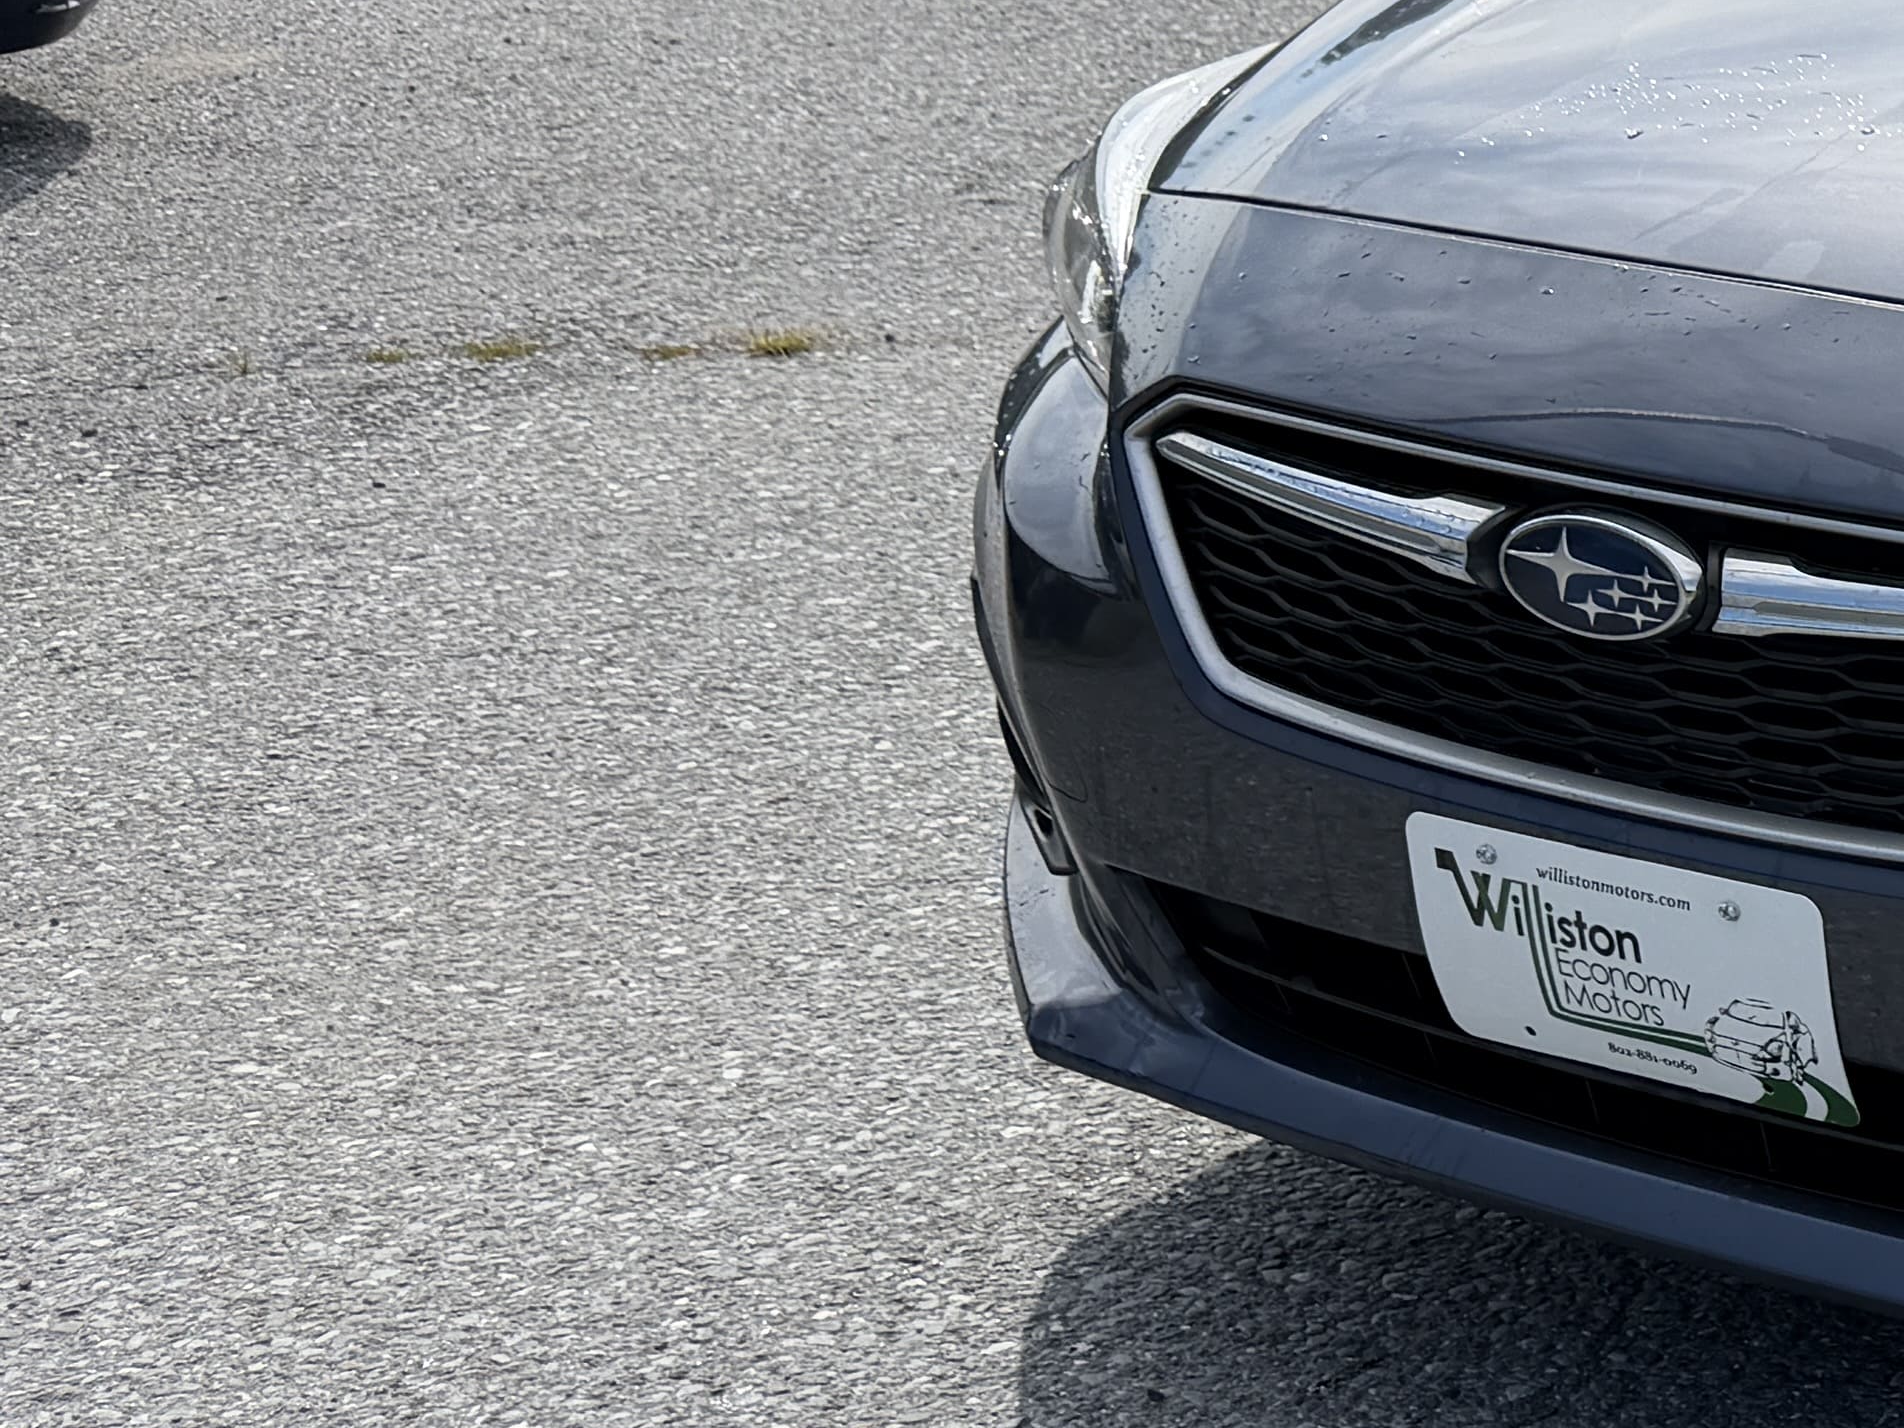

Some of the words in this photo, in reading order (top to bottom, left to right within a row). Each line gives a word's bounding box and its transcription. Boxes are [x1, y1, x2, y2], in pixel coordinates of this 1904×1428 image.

[1434, 847, 1642, 963] Williston
[1535, 866, 1691, 911] willistonmotors.com
[1555, 947, 1691, 1010] Economy
[1564, 980, 1665, 1027] Motors
